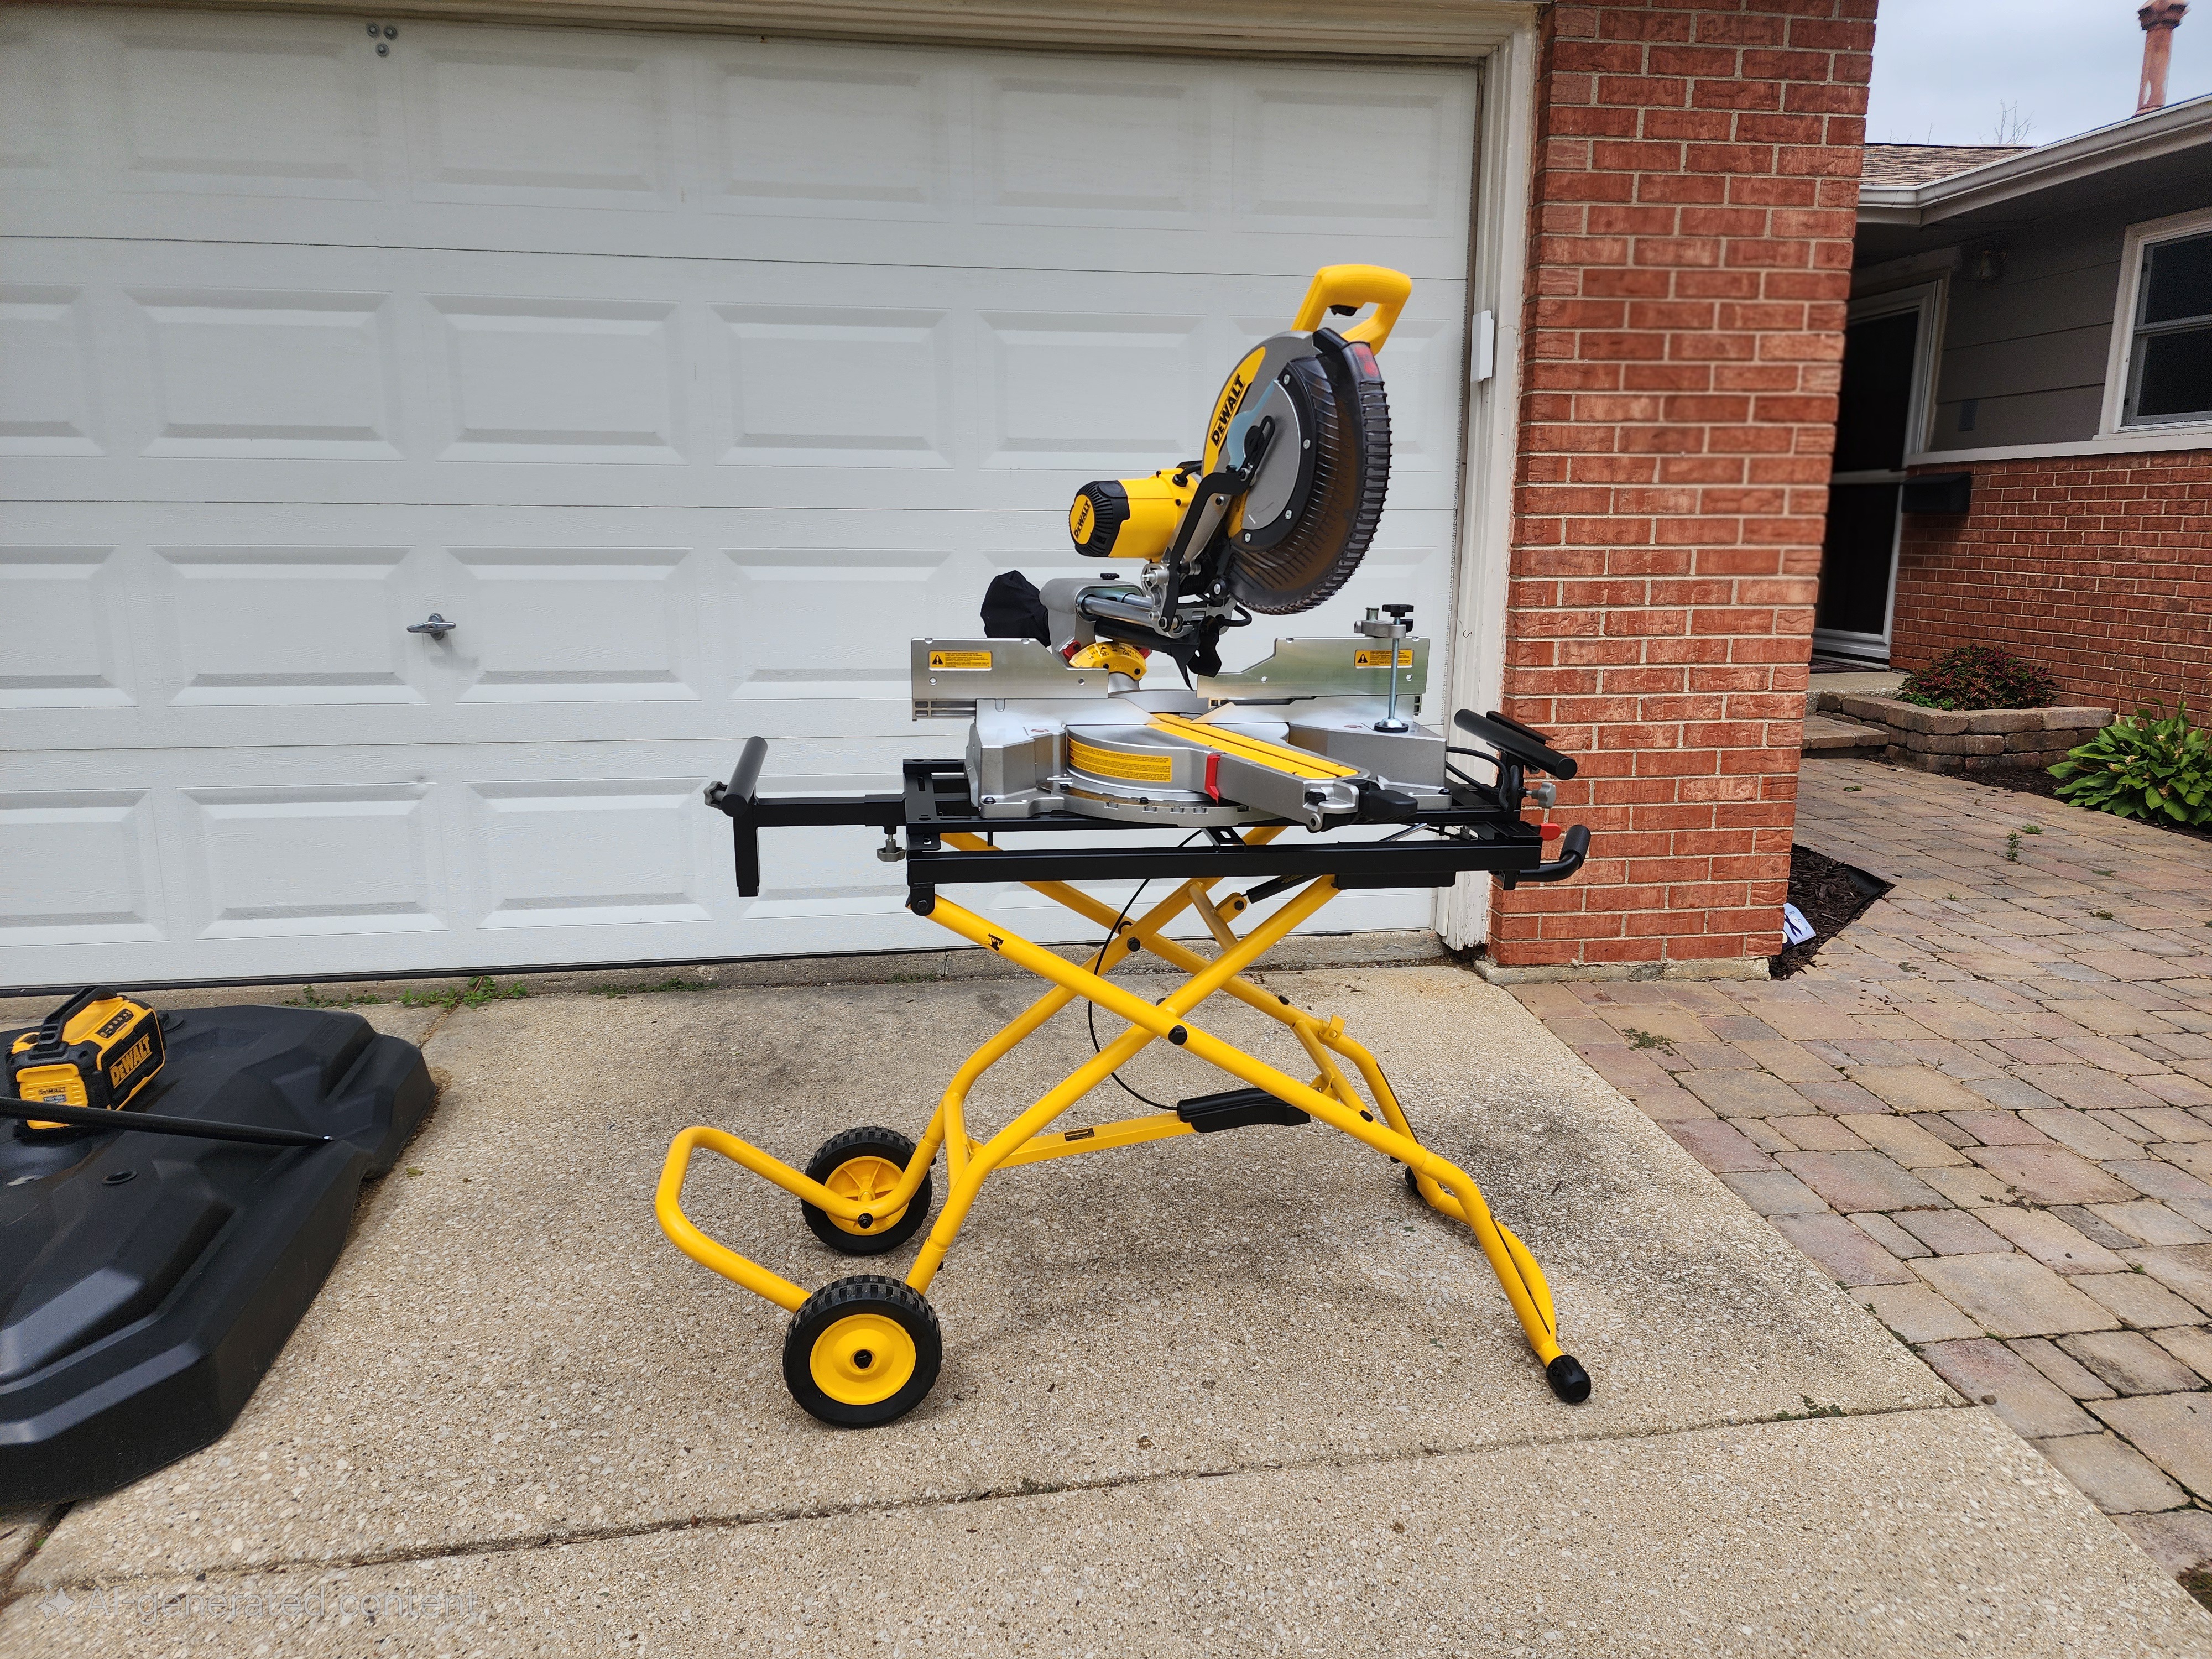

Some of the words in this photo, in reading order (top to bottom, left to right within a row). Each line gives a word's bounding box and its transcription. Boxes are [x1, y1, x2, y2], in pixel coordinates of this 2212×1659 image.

[1211, 372, 1244, 446] DEWALT
[1074, 499, 1091, 539] DEWALT
[110, 1036, 150, 1087] DEWALT
